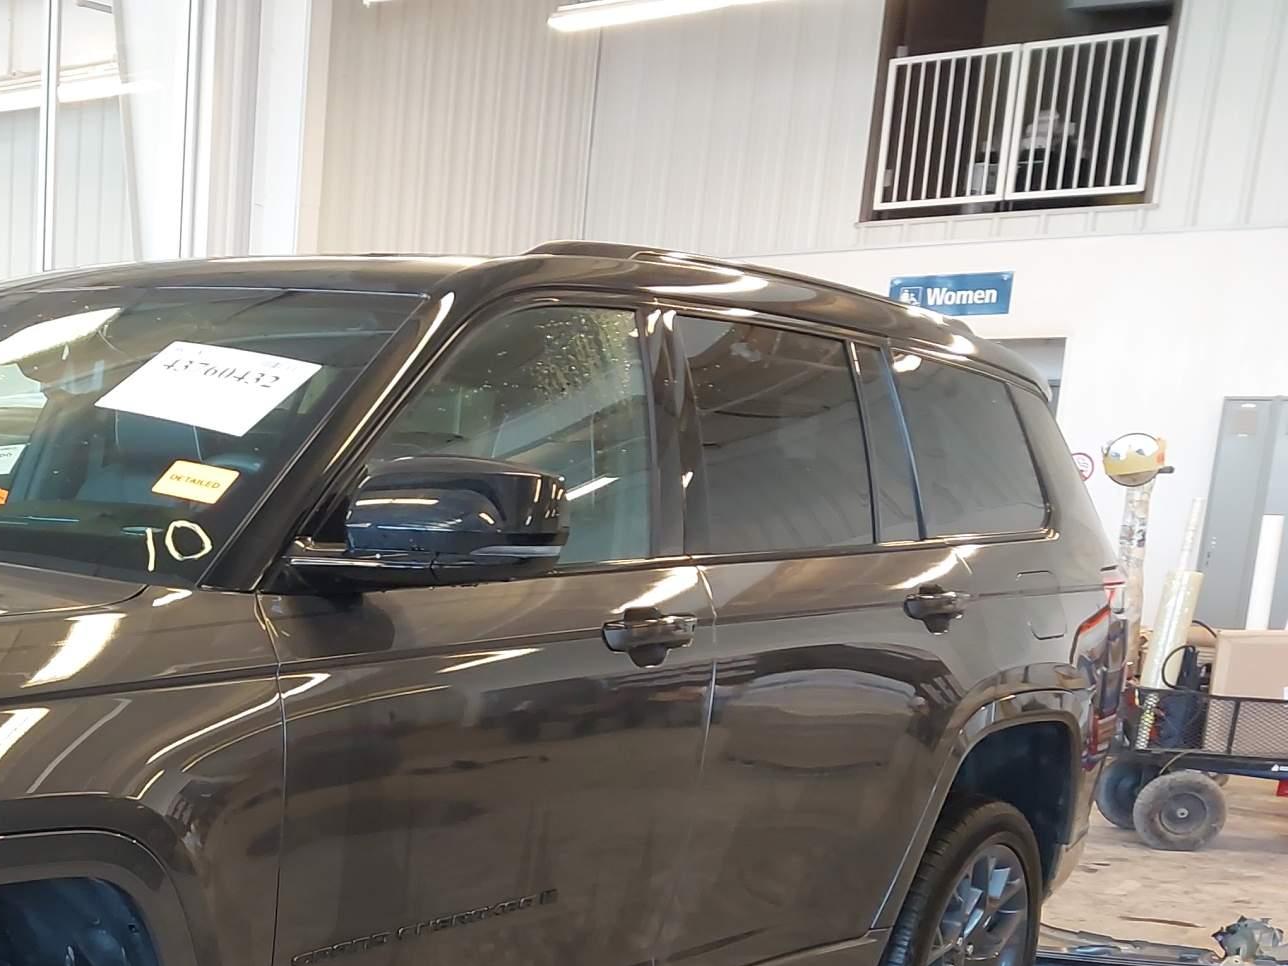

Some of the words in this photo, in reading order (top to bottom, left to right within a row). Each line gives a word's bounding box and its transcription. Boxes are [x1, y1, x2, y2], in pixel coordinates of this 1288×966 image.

[926, 287, 998, 306] Women
[162, 359, 281, 388] 43760432
[169, 473, 221, 489] DETAILED
[146, 520, 213, 572] 10
